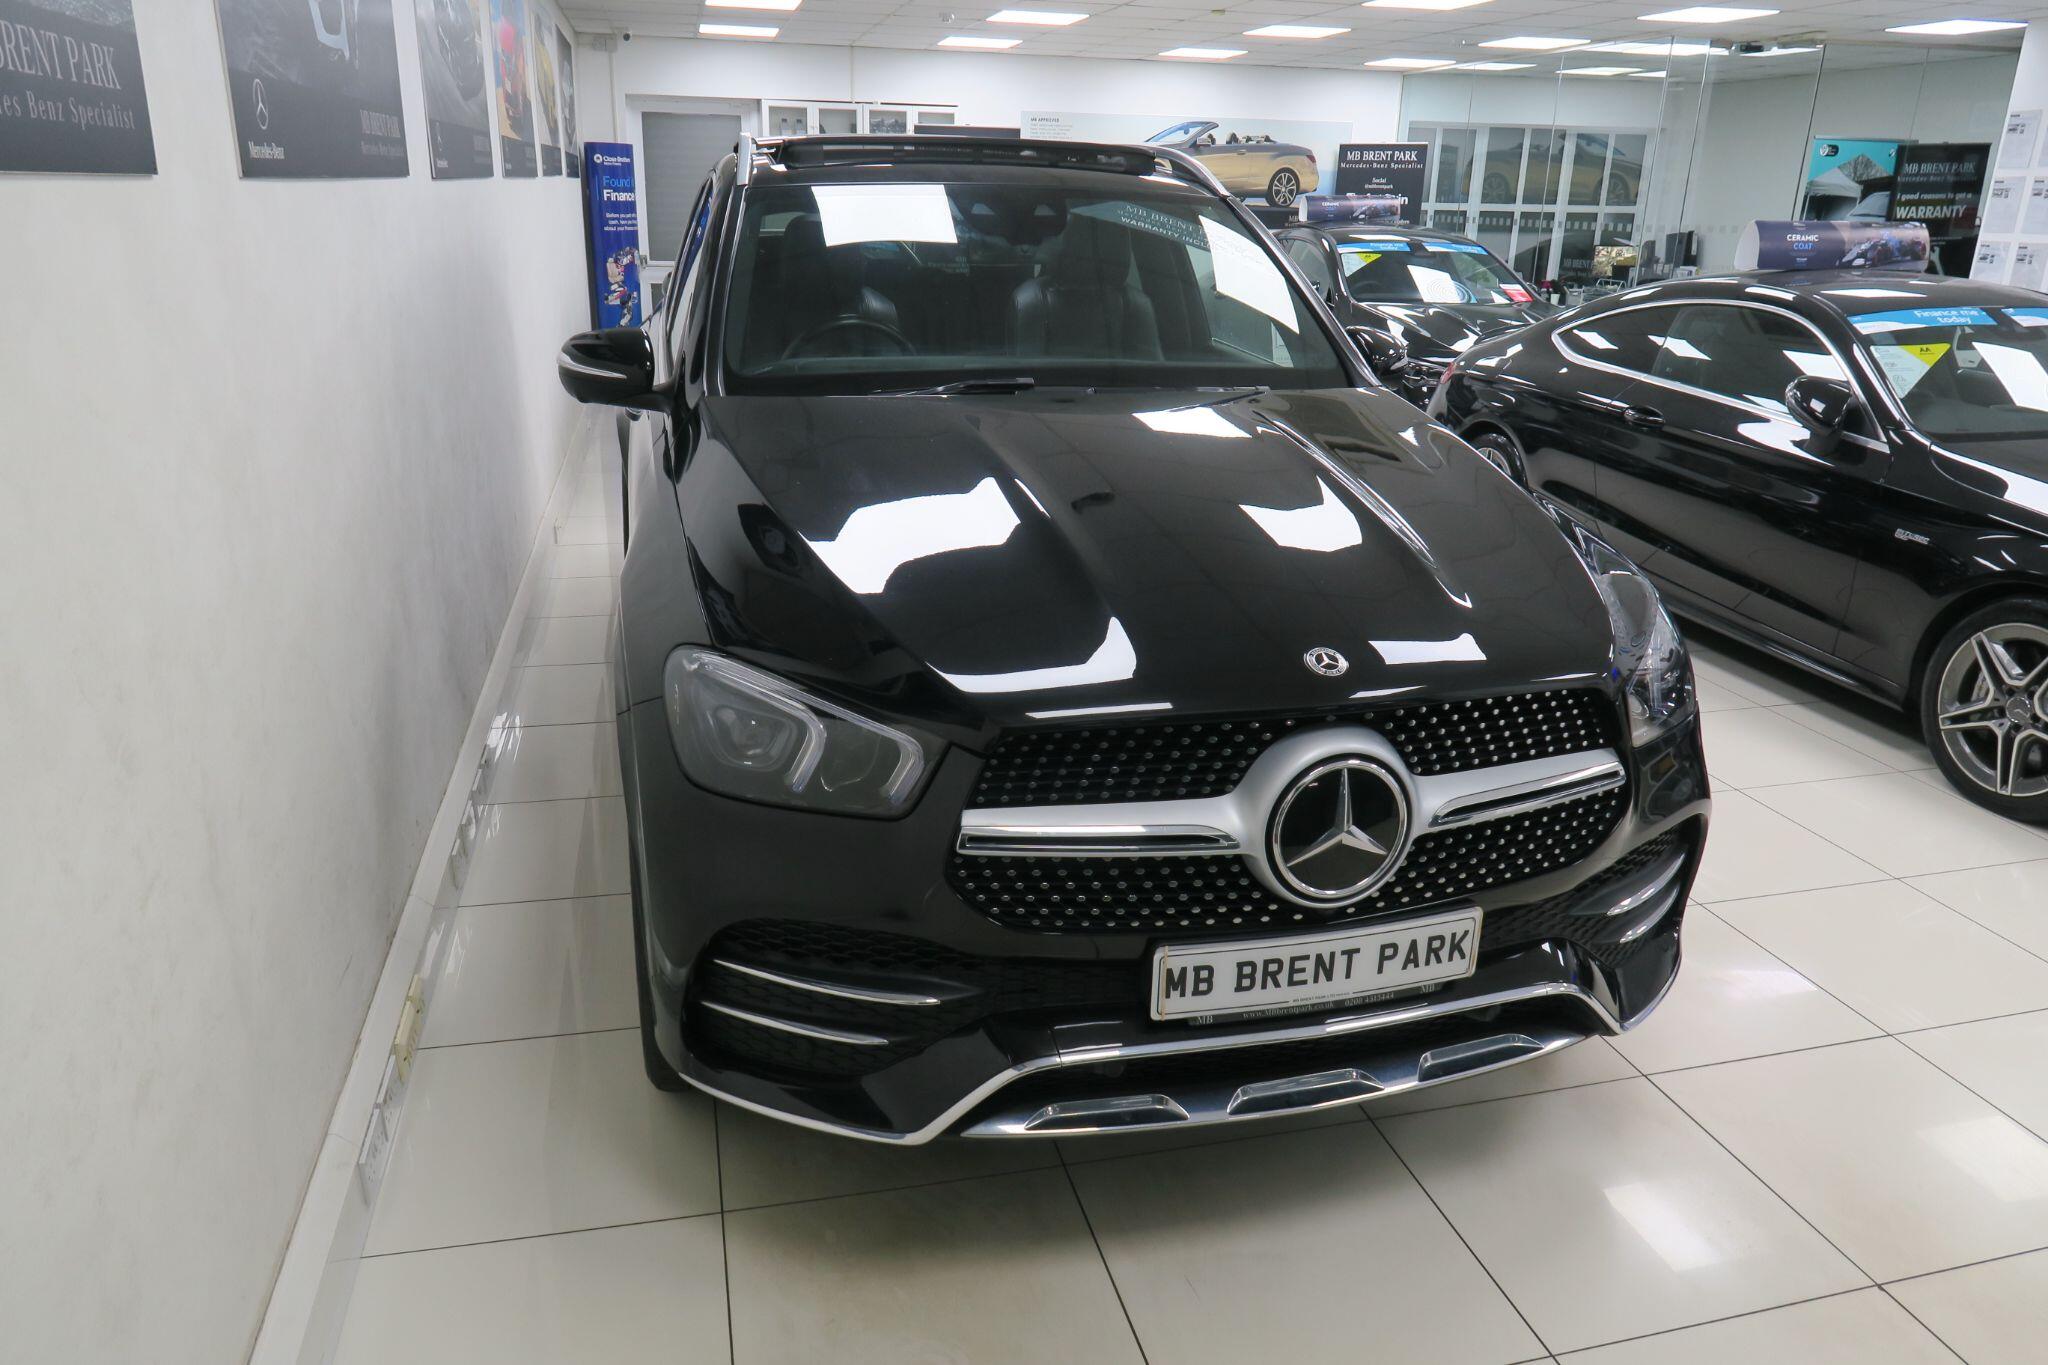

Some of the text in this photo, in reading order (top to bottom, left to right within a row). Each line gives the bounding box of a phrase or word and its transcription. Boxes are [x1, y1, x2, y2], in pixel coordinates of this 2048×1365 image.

[0, 20, 122, 90] RENT PARK
[26, 90, 65, 122] Benz
[68, 97, 136, 131] Specialist
[1346, 151, 1418, 161] MB BRENT PARK
[1904, 162, 1976, 174] MB BRENT PARK
[603, 176, 631, 188] Found
[1901, 192, 1920, 202] good
[1896, 205, 1967, 219] WARRANTY
[1121, 216, 1180, 238] WARRANTY
[1151, 212, 1196, 232] BRENT
[1793, 242, 1814, 250] COAT
[1913, 310, 1960, 318] Finance
[1937, 315, 1971, 325] today
[1164, 929, 1470, 999] MB BRENT PARK
[1420, 984, 1436, 993] MB
[1196, 1015, 1213, 1025] MB
